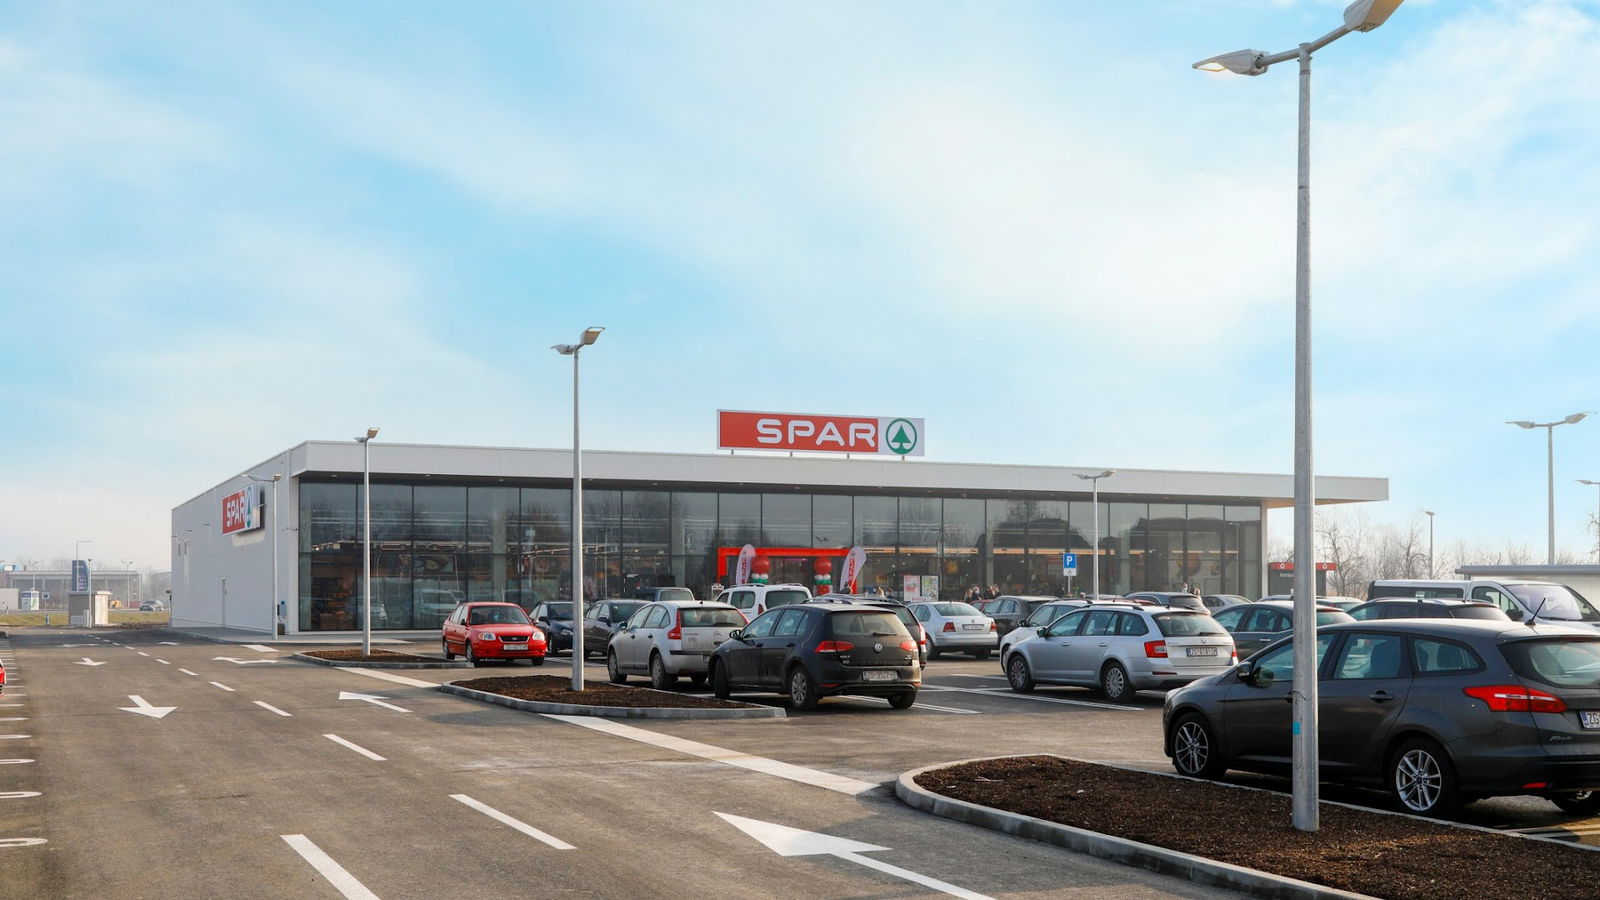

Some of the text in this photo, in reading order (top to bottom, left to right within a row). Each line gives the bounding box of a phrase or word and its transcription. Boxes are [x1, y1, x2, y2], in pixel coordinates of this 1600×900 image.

[756, 418, 876, 448] SPAR
[226, 496, 245, 528] SPAR
[1587, 712, 1600, 725] ZG
